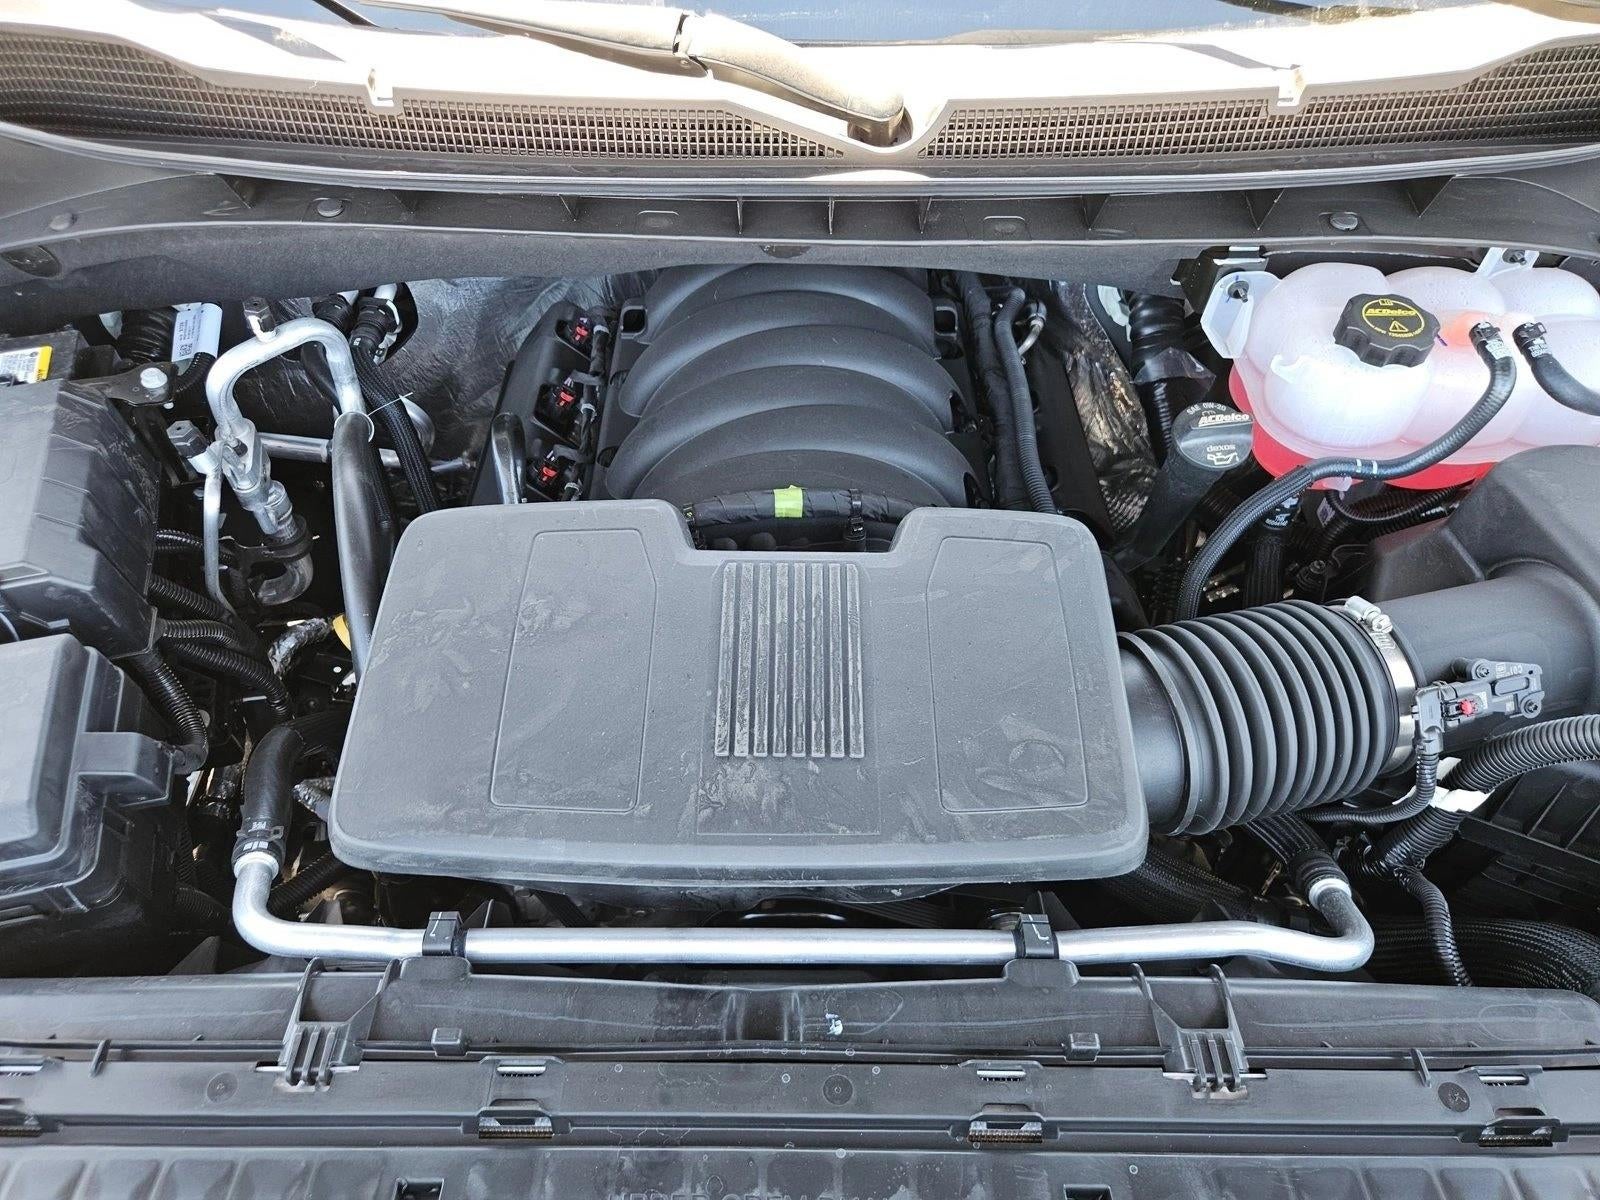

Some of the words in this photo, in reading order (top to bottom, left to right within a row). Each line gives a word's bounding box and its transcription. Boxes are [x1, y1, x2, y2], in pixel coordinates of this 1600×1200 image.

[1365, 308, 1417, 317] ACDelco
[1186, 404, 1201, 415] SAE
[1198, 412, 1251, 427] ACDelco
[1206, 444, 1236, 453] dexos
